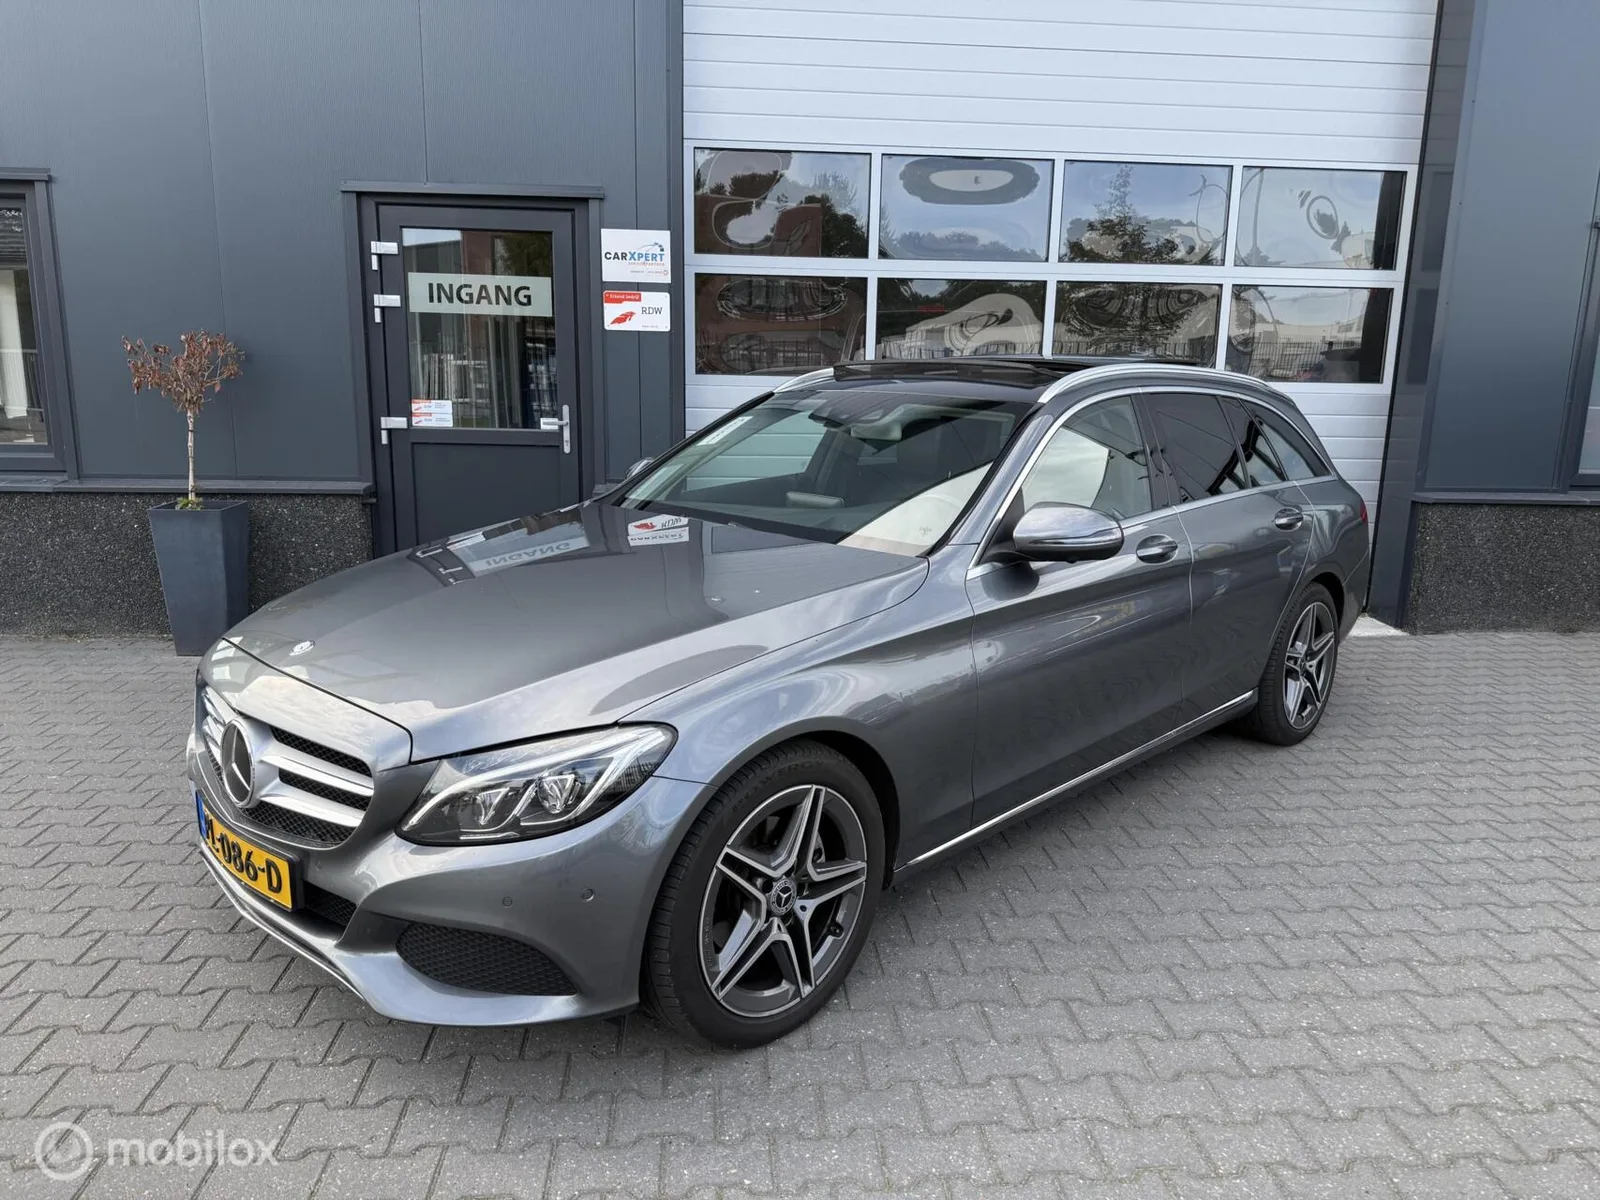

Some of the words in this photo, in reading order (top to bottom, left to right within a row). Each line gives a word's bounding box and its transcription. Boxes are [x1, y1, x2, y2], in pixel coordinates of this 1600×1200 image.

[604, 251, 665, 262] CARXPERT
[428, 282, 532, 307] INGANG
[641, 306, 663, 315] RDW
